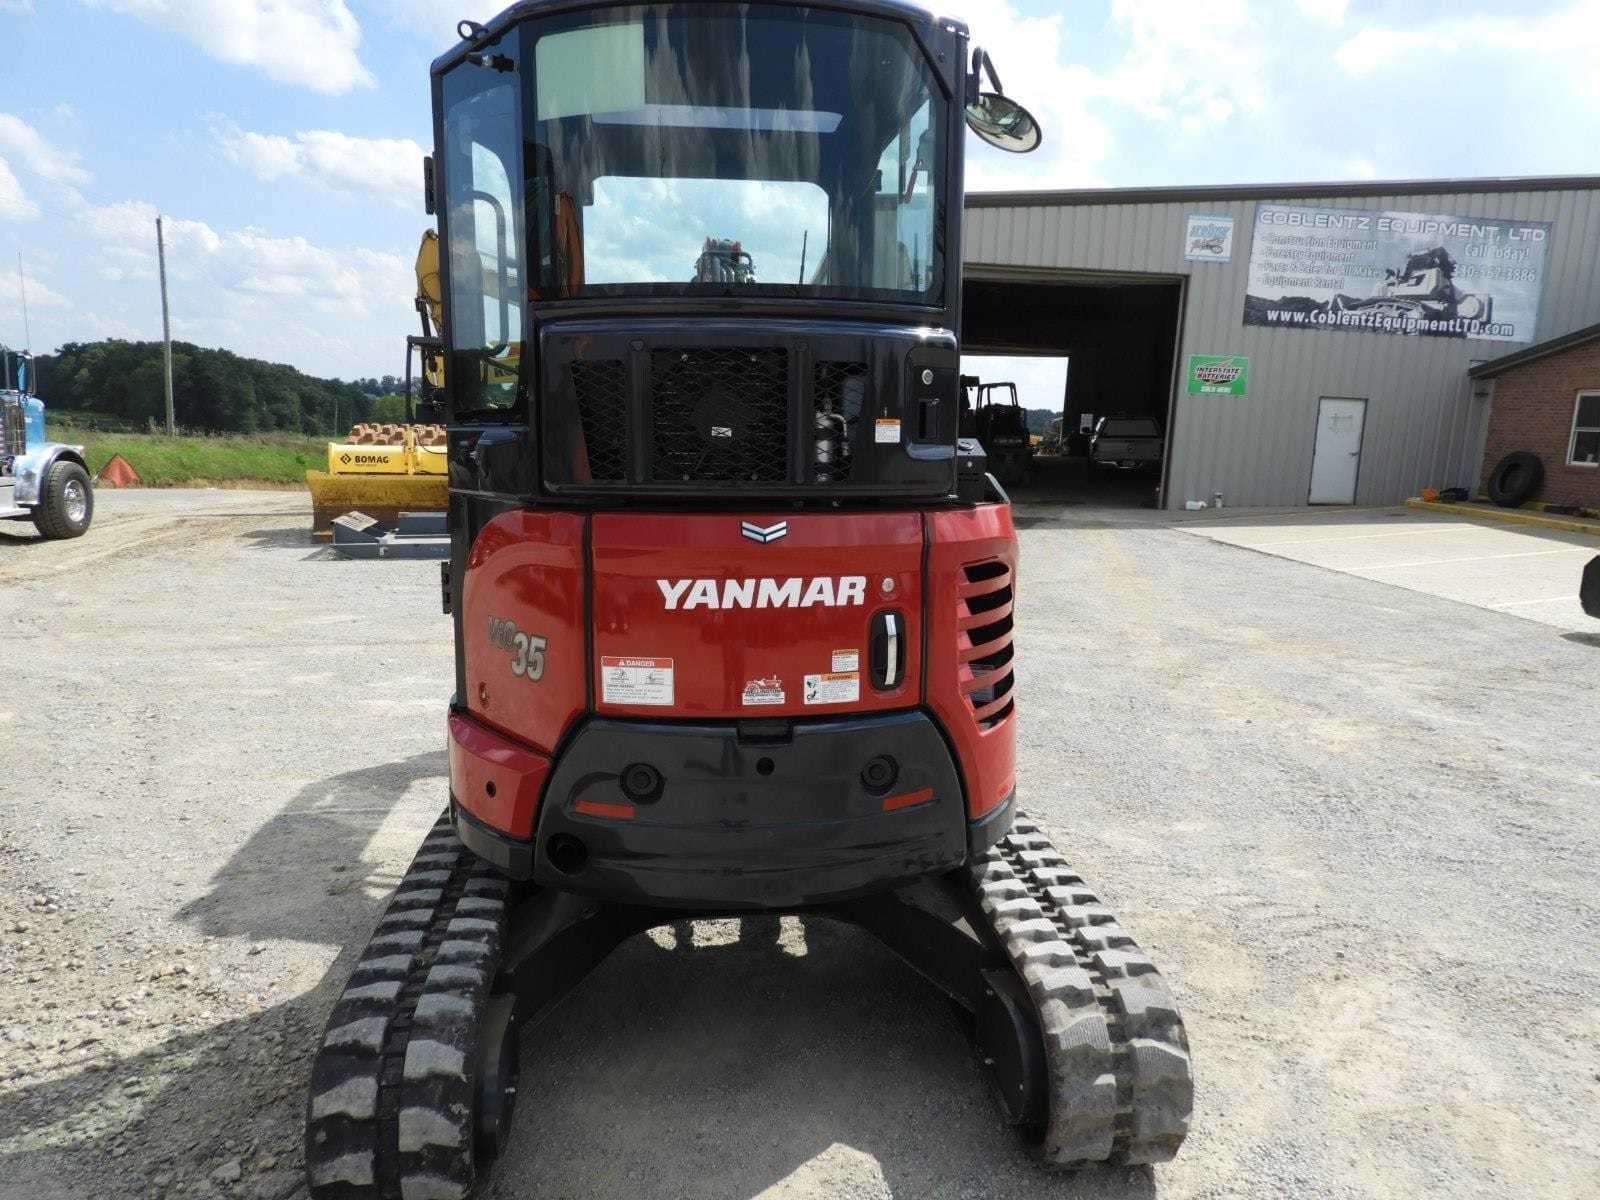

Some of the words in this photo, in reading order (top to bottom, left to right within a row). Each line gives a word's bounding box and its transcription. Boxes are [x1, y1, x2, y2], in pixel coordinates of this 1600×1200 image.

[1260, 211, 1370, 230] COBLENTZ
[1378, 218, 1501, 241] EQUIPMENT,
[1508, 227, 1546, 242] LTD
[1267, 233, 1325, 248] Construction
[1327, 236, 1377, 251] Equipment
[1265, 246, 1304, 262] Forestry
[1305, 248, 1354, 263] Equipment
[1464, 243, 1488, 257] Call
[1489, 245, 1530, 262] Today!
[1262, 273, 1312, 288] Equipment
[1313, 277, 1345, 289] Rental
[1267, 309, 1513, 336] www.CoblentzEquipmentLTD.com
[355, 455, 389, 464] BOMAG
[656, 576, 867, 610] YANMAR
